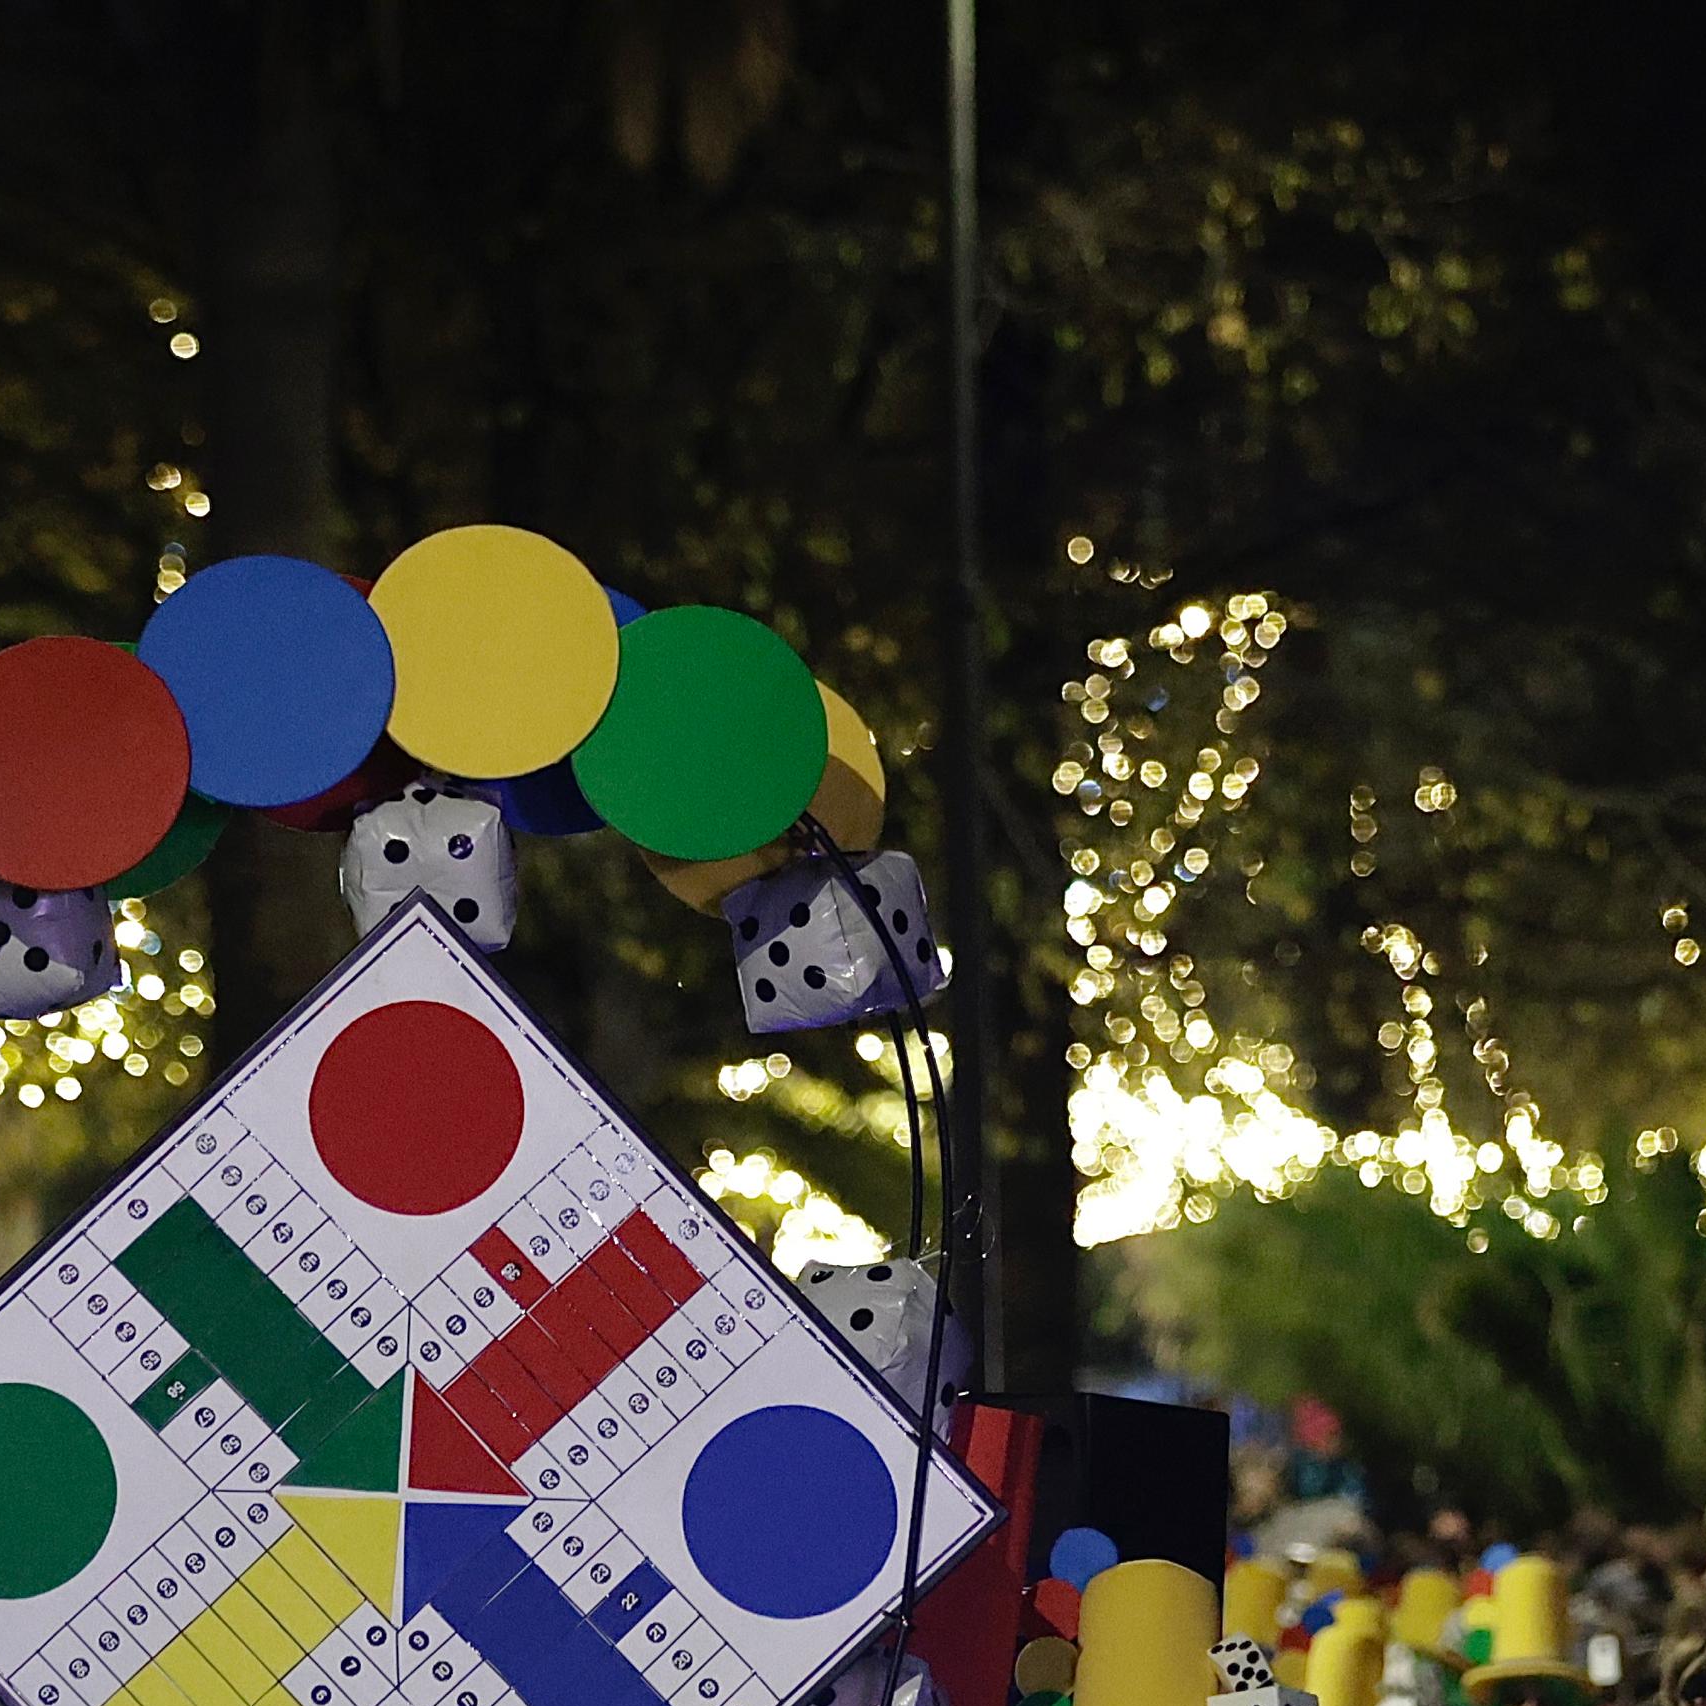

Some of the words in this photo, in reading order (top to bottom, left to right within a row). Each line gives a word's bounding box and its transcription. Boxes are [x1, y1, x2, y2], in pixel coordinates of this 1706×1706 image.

[197, 1135, 216, 1153] 50
[129, 1200, 147, 1218] 51
[275, 1225, 291, 1243] 47
[531, 1237, 548, 1256] 38
[59, 1265, 78, 1283] 52
[502, 1262, 522, 1281] 39
[328, 1281, 346, 1299] 45
[475, 1288, 492, 1307] 40
[88, 1296, 107, 1314] 53
[352, 1309, 370, 1327] 44
[447, 1316, 463, 1333] 41
[378, 1338, 396, 1355] 43
[421, 1342, 438, 1361] 42
[688, 1341, 705, 1360] 31
[142, 1352, 160, 1370] 55
[658, 1368, 675, 1386] 30
[166, 1379, 186, 1397] 56
[198, 1408, 215, 1427] 57
[222, 1436, 240, 1454] 58
[569, 1447, 587, 1464] 27
[250, 1464, 269, 1482] 59
[541, 1470, 559, 1488] 26
[249, 1505, 267, 1523] 60
[534, 1513, 552, 1532] 25
[218, 1530, 234, 1546] 61
[564, 1537, 582, 1556] 24
[186, 1554, 204, 1573] 62
[592, 1564, 610, 1583] 23
[159, 1579, 176, 1597] 63
[621, 1592, 639, 1611] 22
[129, 1606, 147, 1624] 64
[101, 1632, 118, 1650] 65
[648, 1624, 665, 1641] 21
[673, 1651, 691, 1670] 20
[434, 1663, 450, 1679] 10
[40, 1686, 59, 1702] 67
[700, 1680, 716, 1696] 19
